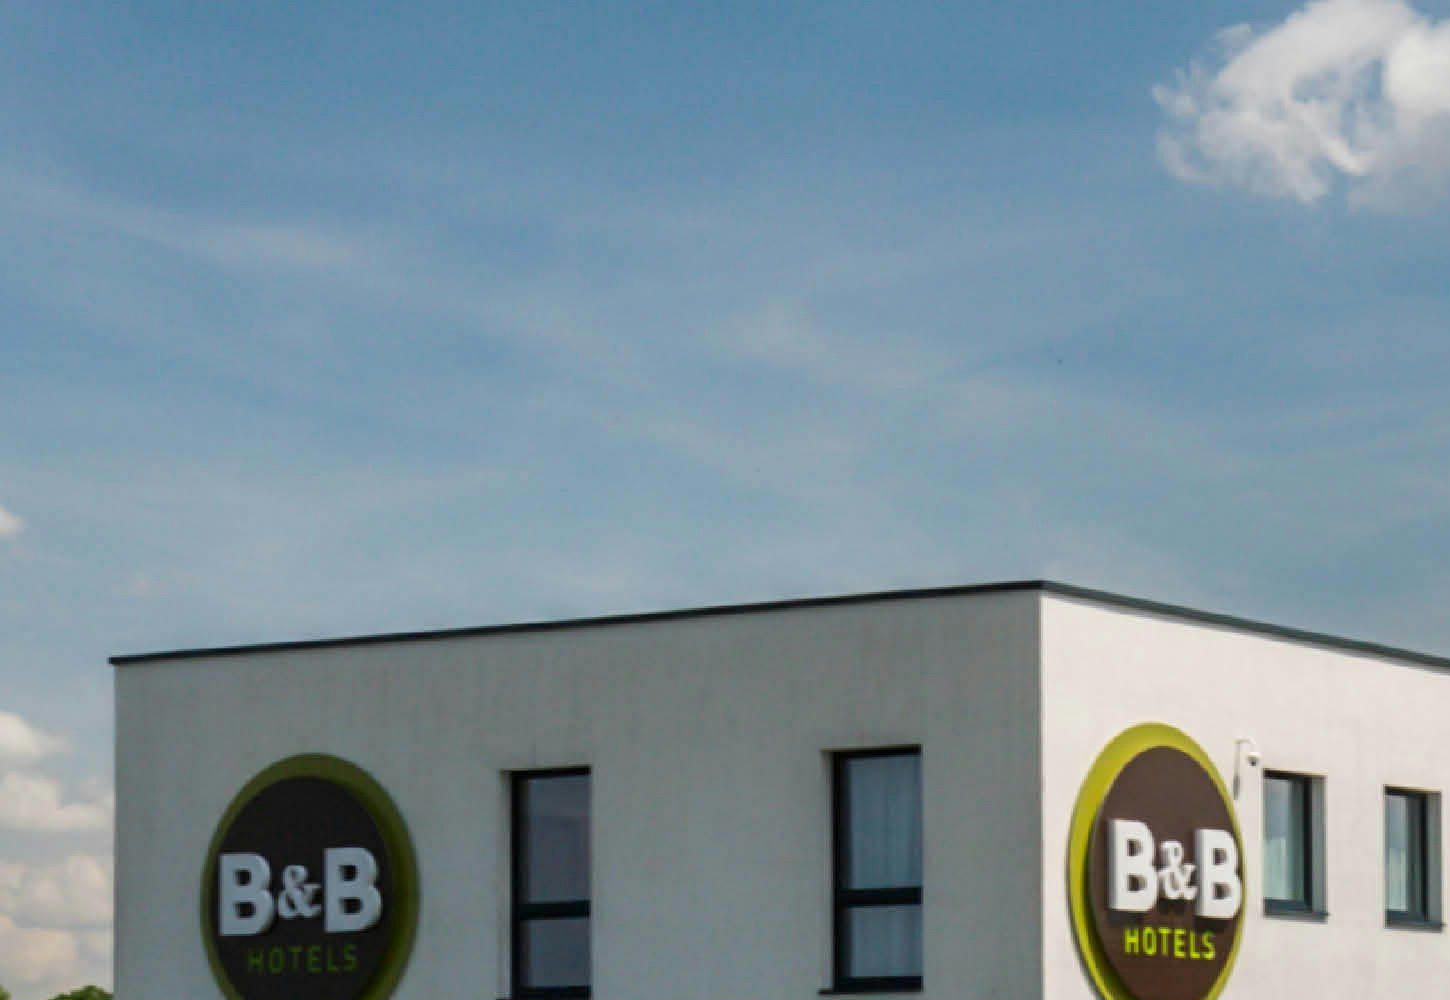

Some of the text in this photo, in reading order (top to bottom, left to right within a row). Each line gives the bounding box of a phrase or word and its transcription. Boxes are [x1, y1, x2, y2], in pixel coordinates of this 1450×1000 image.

[219, 847, 382, 937] B&B
[1109, 819, 1242, 919] B&B
[247, 943, 358, 976] HOTELS
[1124, 926, 1215, 960] HOTELS
